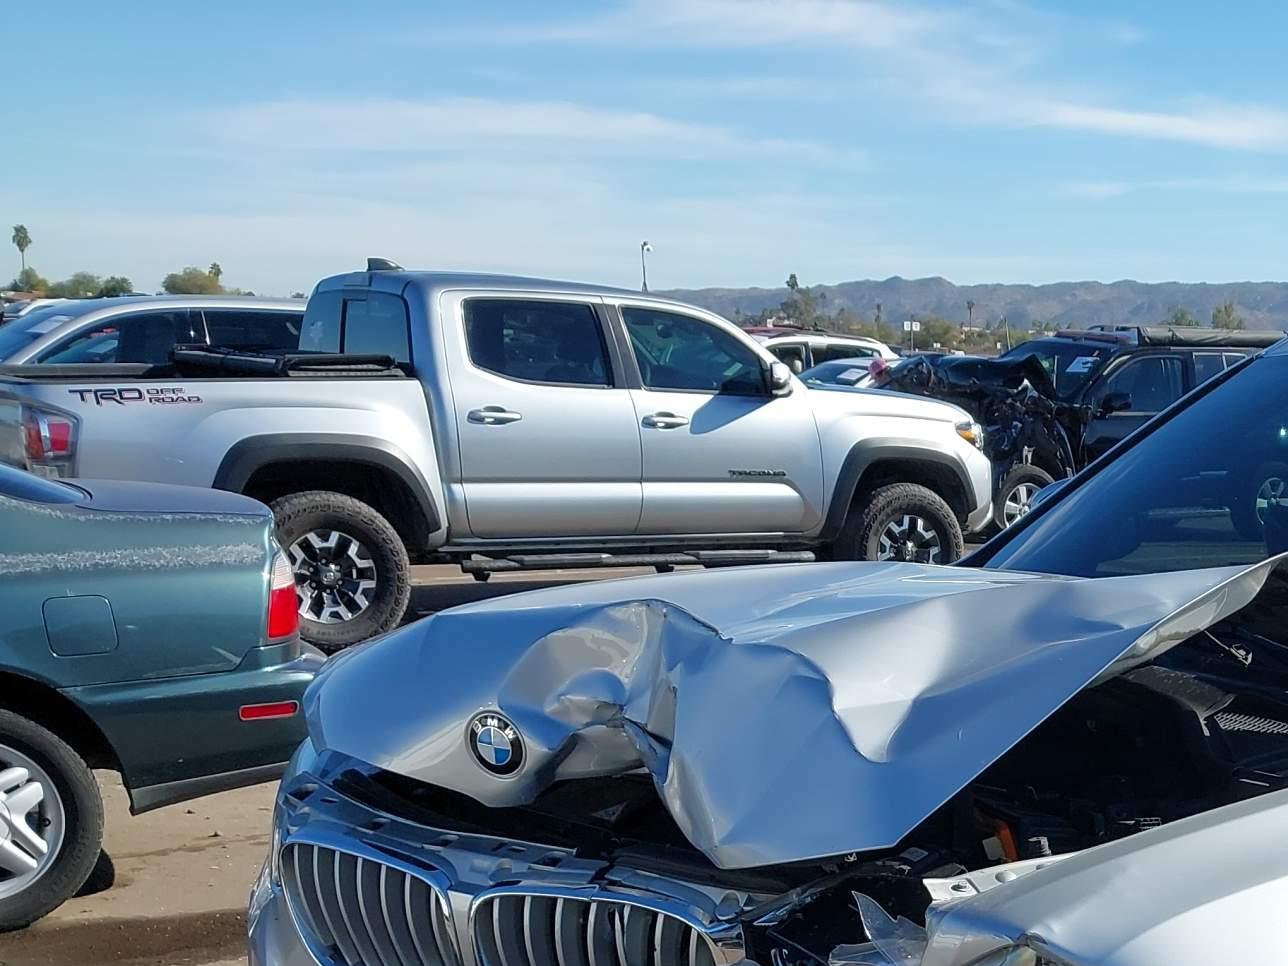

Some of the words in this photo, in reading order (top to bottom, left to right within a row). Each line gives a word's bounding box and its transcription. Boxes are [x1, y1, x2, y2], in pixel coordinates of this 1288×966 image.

[146, 387, 185, 395] OFF
[68, 387, 145, 406] TRD
[148, 396, 203, 404] ROAD
